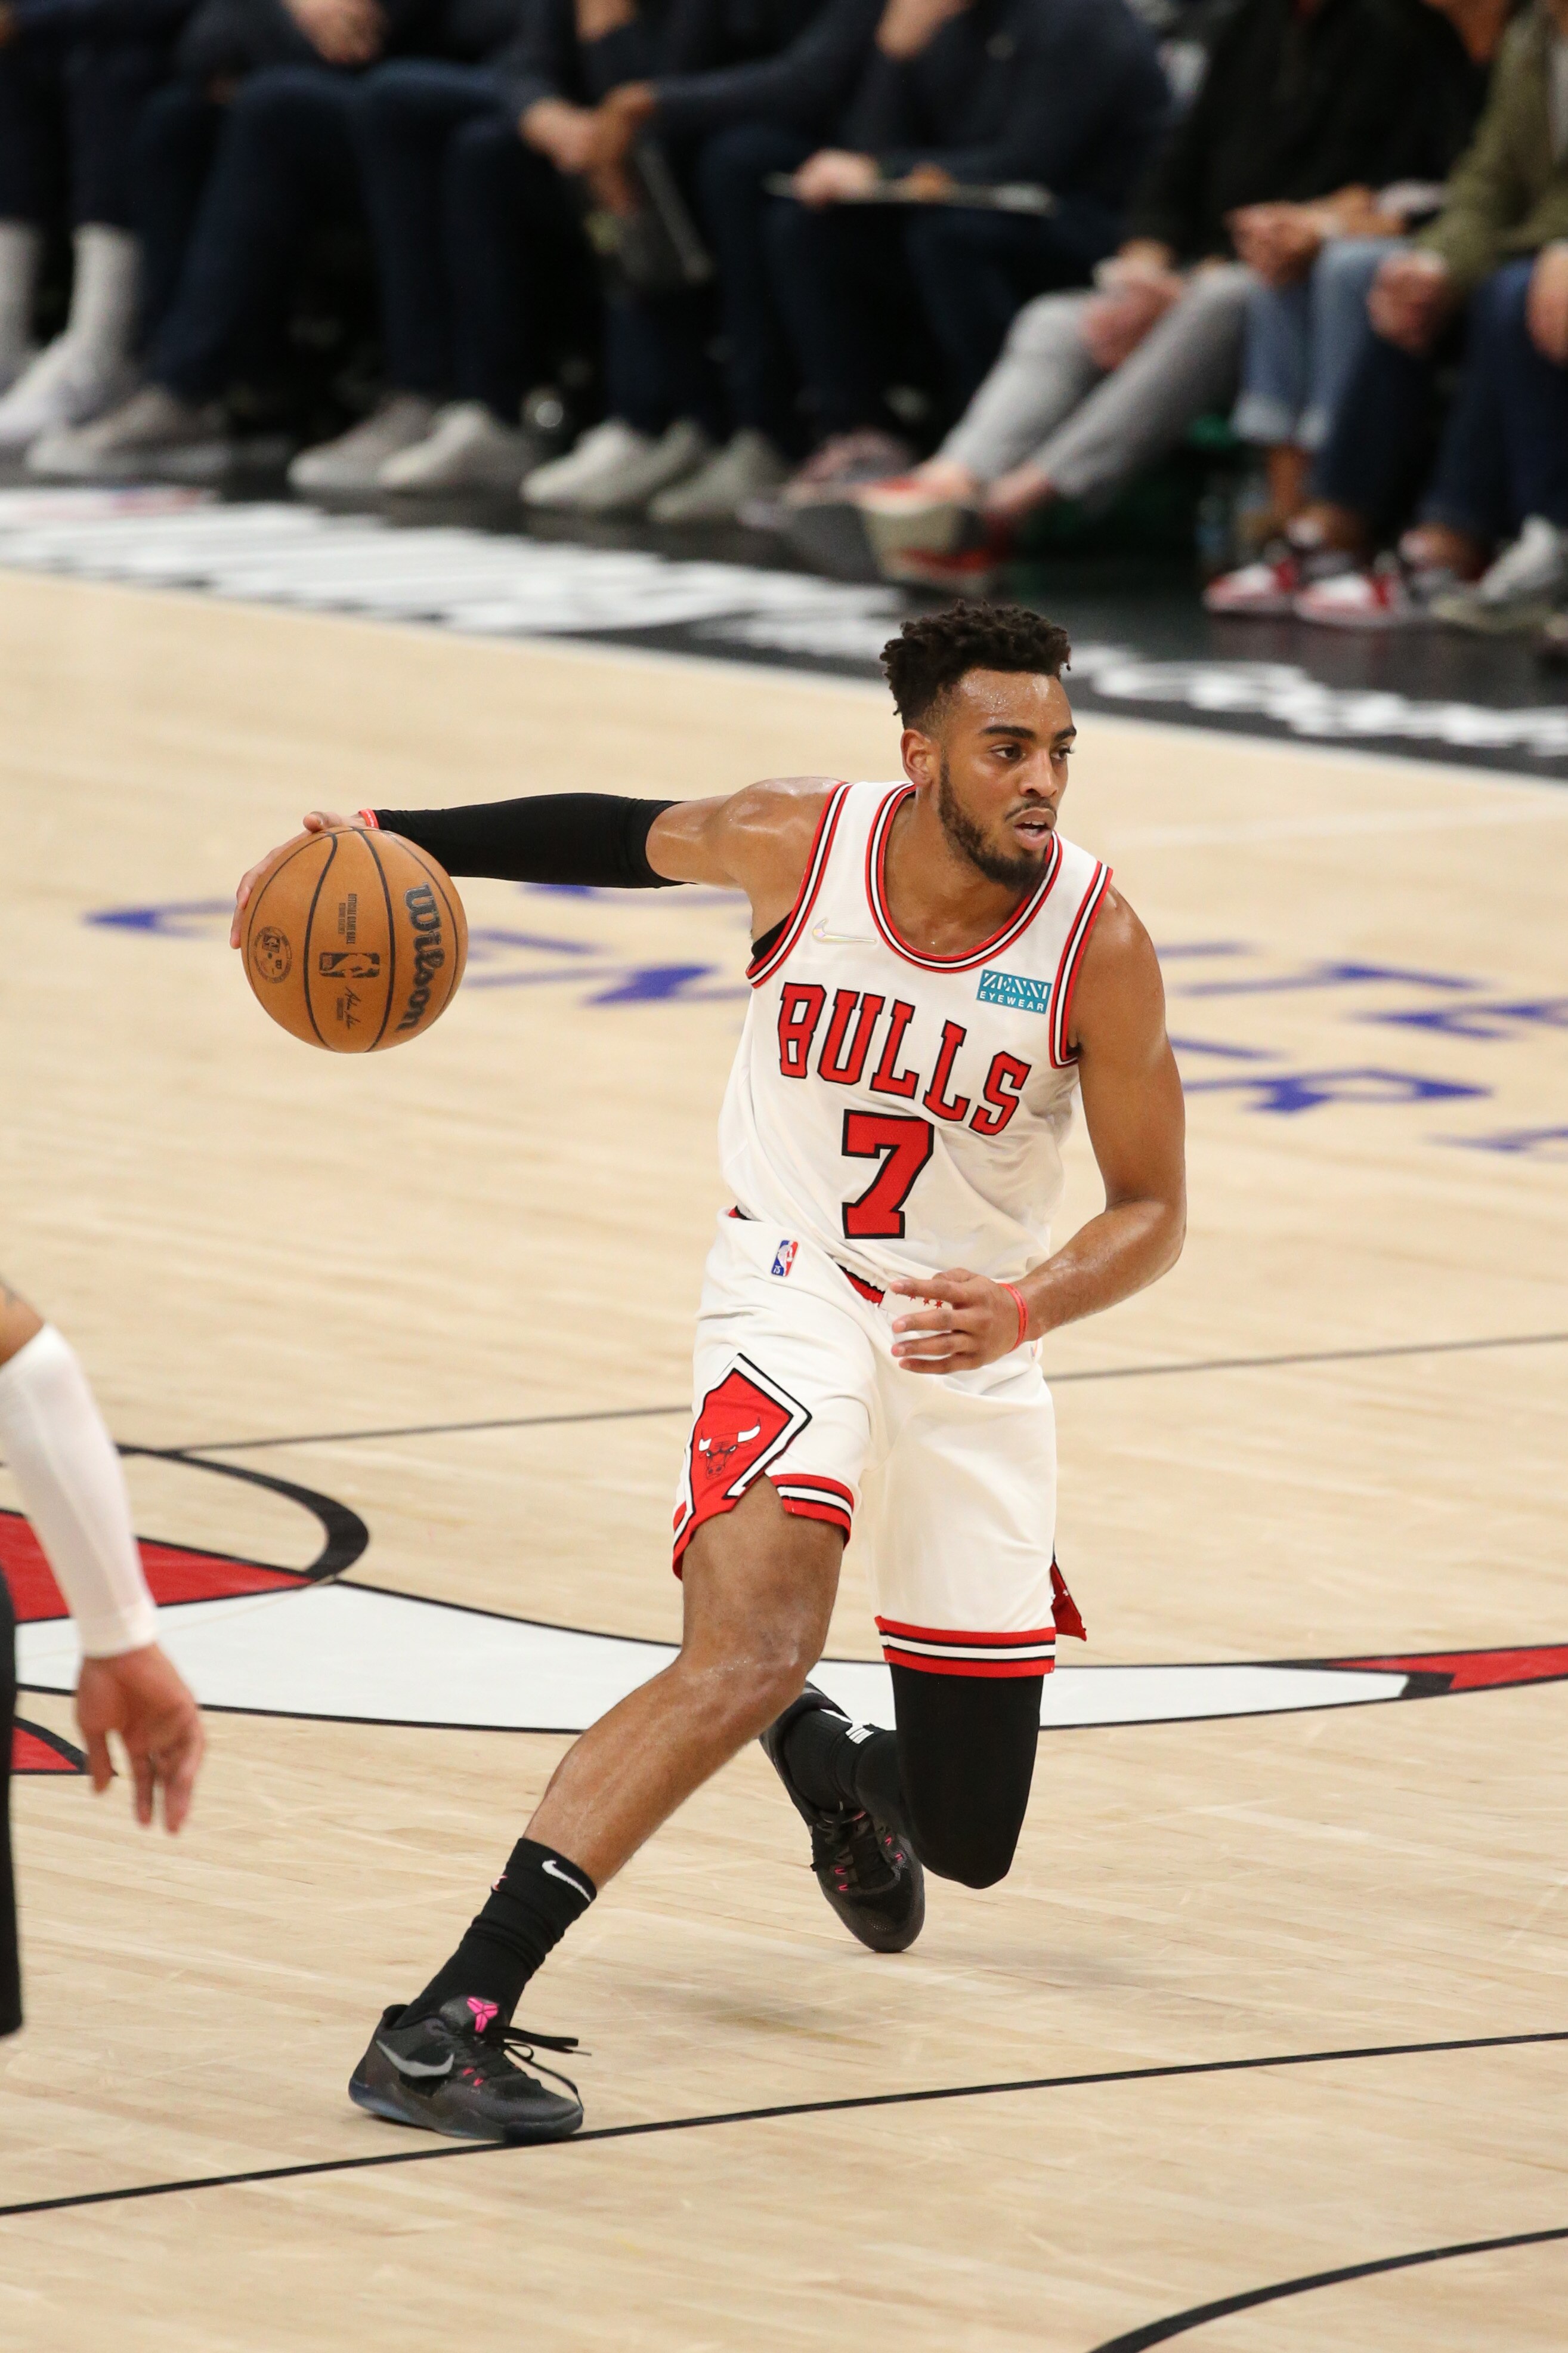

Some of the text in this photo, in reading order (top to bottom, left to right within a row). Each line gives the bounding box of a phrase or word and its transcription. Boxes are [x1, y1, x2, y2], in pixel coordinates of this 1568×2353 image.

[395, 882, 444, 1031] Wilson
[979, 990, 1044, 1012] EYEWEAR
[983, 973, 1048, 999] ZENNI
[778, 981, 1032, 1136] BULLS
[842, 1108, 935, 1239] 7
